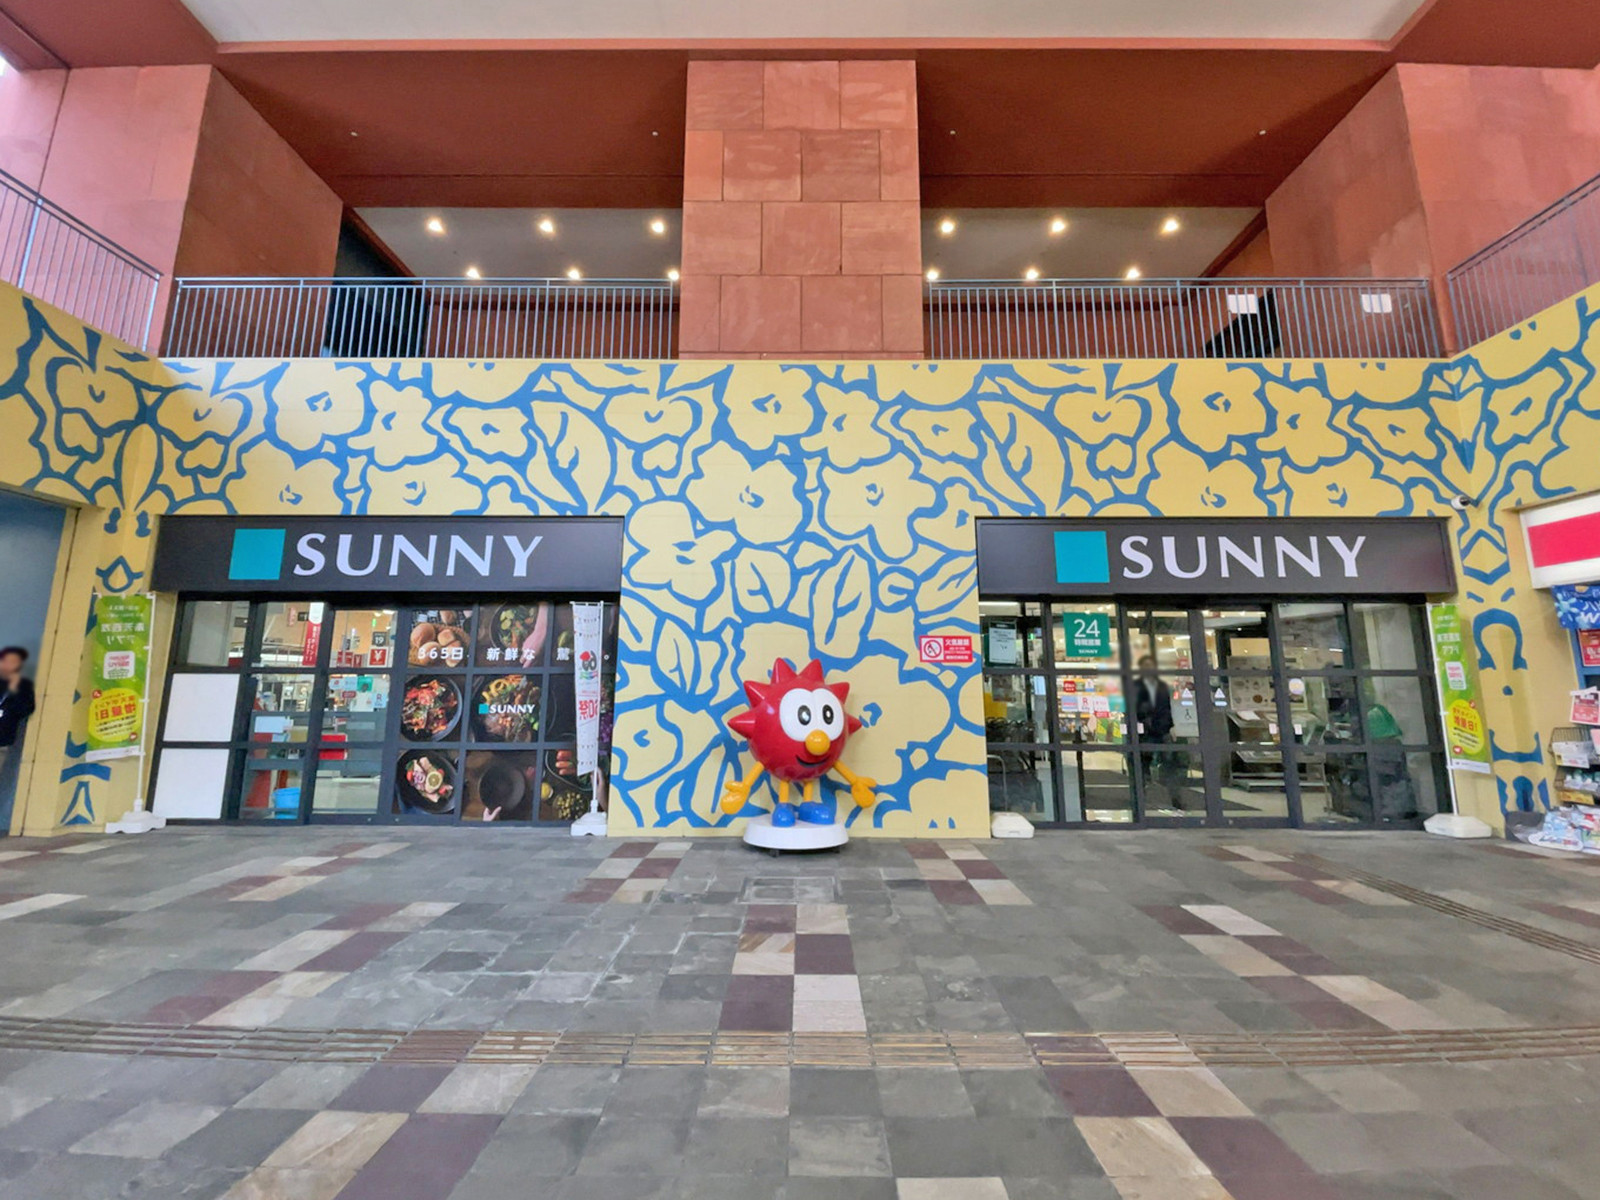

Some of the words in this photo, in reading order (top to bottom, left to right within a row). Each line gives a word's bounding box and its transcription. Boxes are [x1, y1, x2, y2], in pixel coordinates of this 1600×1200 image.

[293, 532, 543, 578] SUNNY
[1121, 534, 1367, 579] SUNNY
[1073, 619, 1100, 638] 24
[375, 636, 384, 644] 19
[486, 647, 535, 661] 新鮮な
[489, 703, 535, 714] SUNNY
